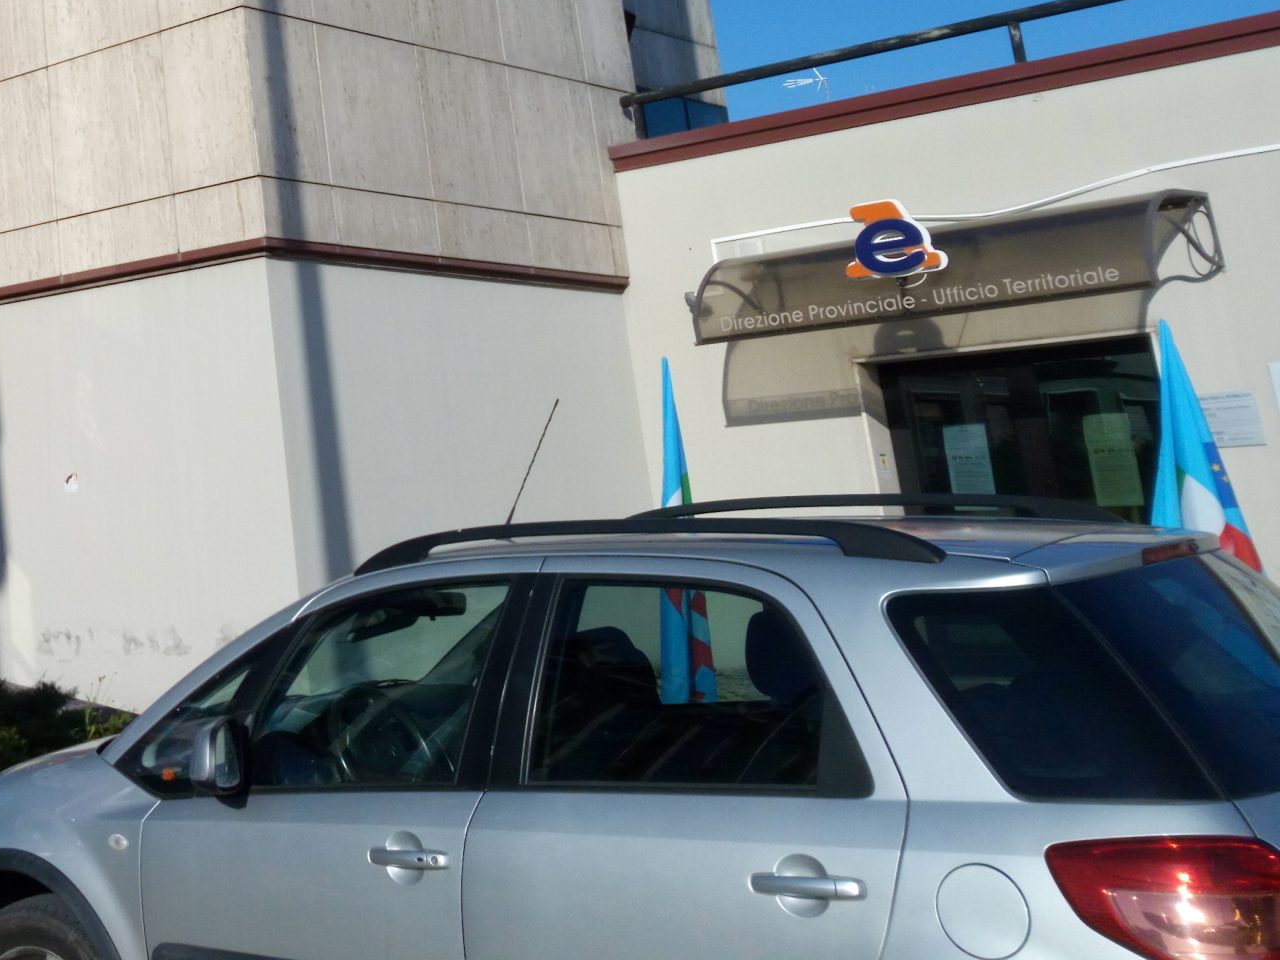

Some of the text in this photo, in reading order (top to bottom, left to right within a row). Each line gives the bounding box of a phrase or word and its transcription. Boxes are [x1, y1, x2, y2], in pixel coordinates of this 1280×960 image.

[721, 309, 804, 332] Direzione
[809, 293, 916, 321] Provinciale
[933, 282, 999, 305] Ufficio
[1002, 266, 1120, 295] Territoriale
